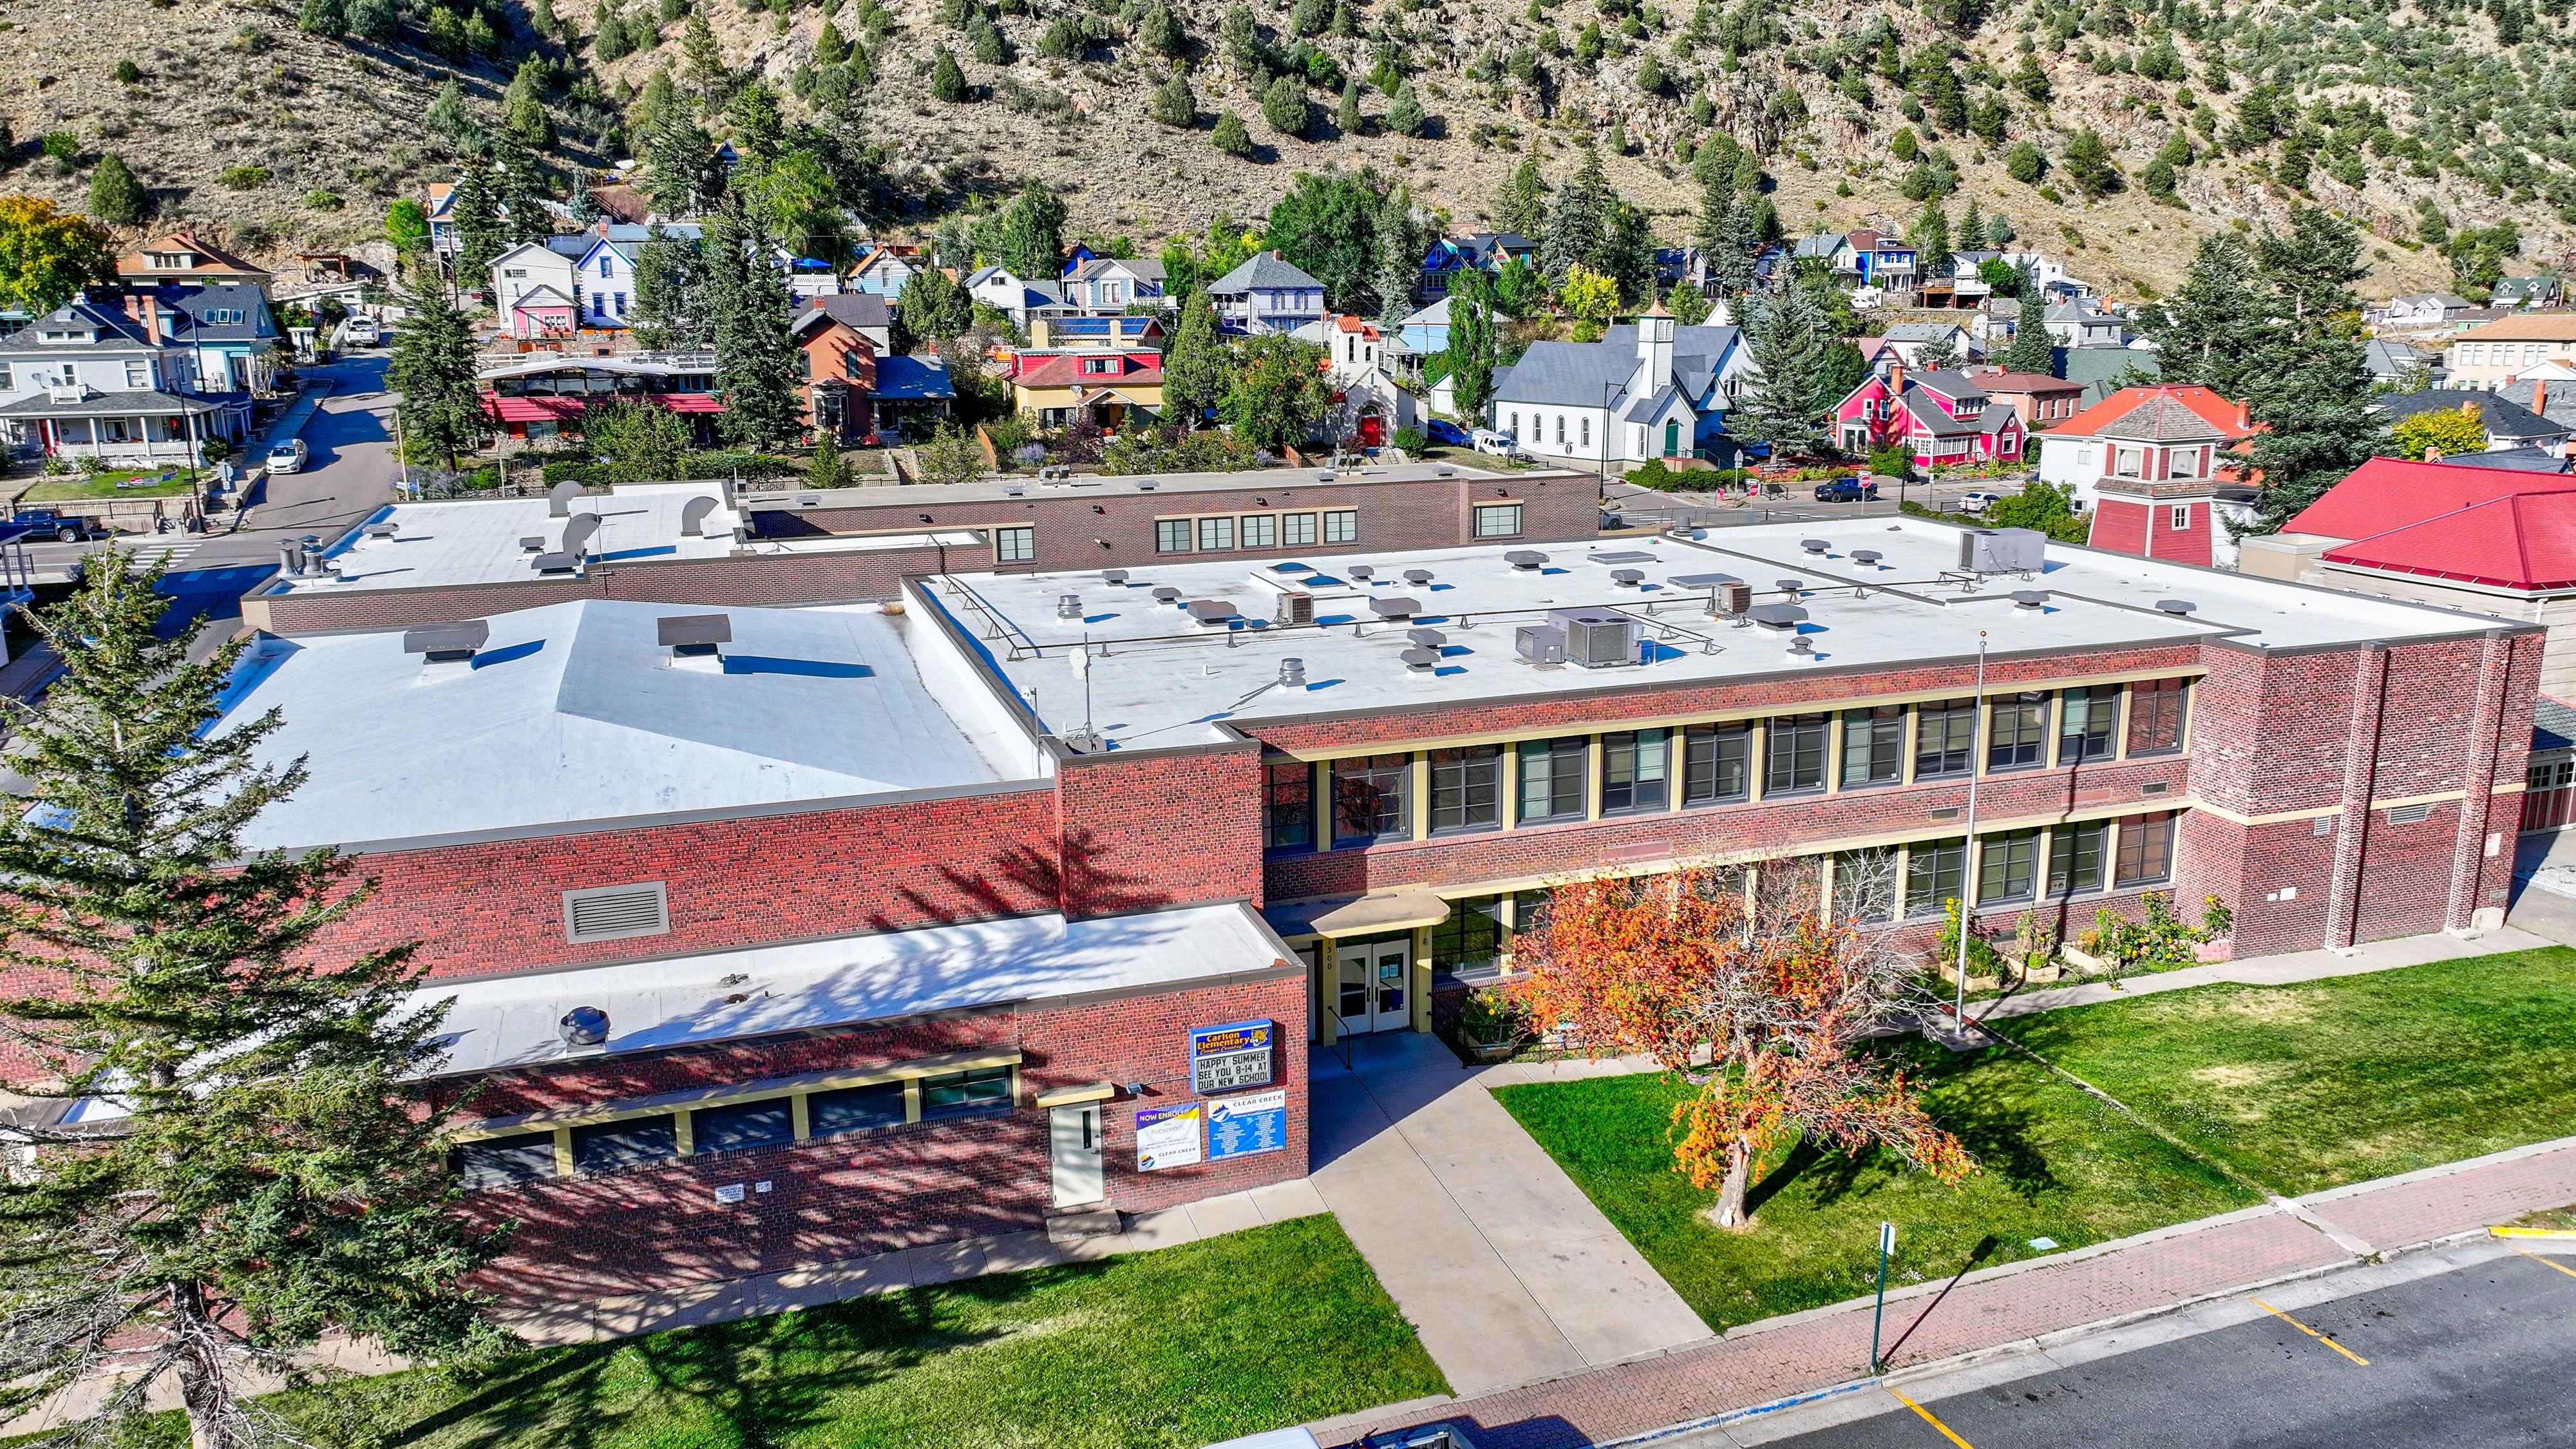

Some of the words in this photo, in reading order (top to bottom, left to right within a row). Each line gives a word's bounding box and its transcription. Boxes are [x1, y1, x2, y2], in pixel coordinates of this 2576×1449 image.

[1206, 1032, 1240, 1042] Carlson
[1197, 1036, 1250, 1050] Elementary
[1220, 1044, 1244, 1052] Country!
[1200, 1058, 1227, 1070] HAPPY
[1233, 1052, 1265, 1065] SUMMER
[1198, 1070, 1211, 1080] SEE
[1215, 1067, 1231, 1077] YOU
[1236, 1065, 1253, 1075] 8-14
[1258, 1062, 1267, 1071] AT
[1198, 1080, 1215, 1090] OUR
[1218, 1077, 1234, 1087] NEW
[1239, 1072, 1269, 1084] SCHOOL
[1259, 1094, 1283, 1103] CREEK
[1139, 1113, 1157, 1122] NOW
[1151, 1125, 1185, 1135] PRESCHOOL
